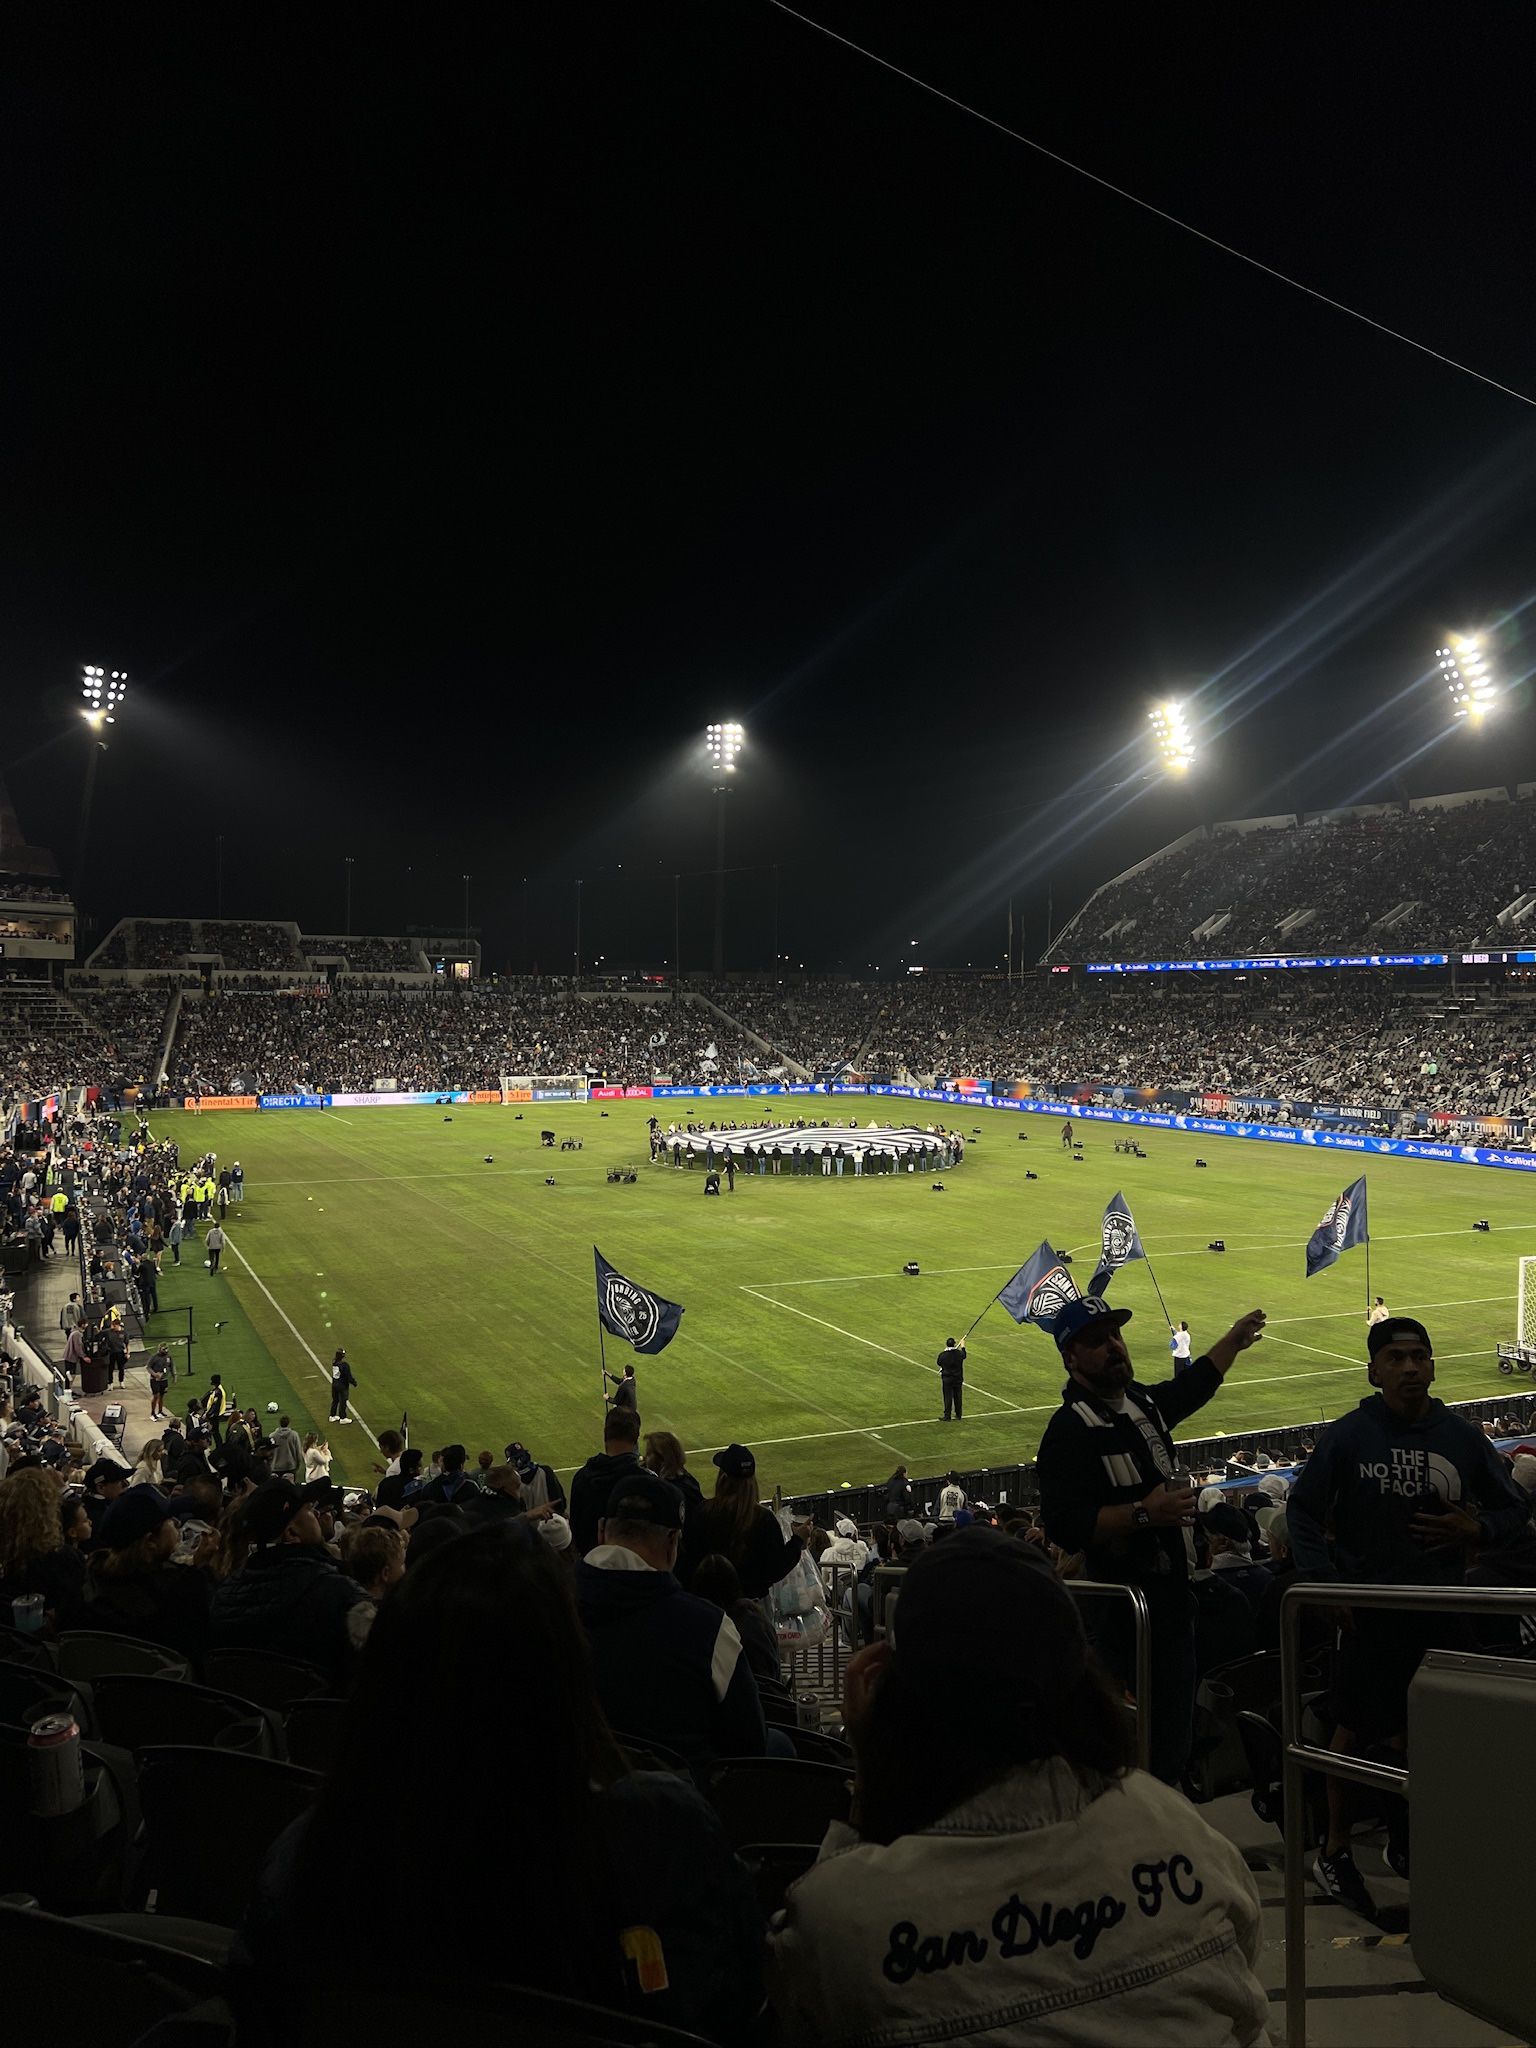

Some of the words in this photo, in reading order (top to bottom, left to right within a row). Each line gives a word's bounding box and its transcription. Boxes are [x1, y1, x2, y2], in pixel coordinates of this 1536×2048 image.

[263, 1097, 301, 1106] DIRECTV
[354, 1096, 381, 1104] SHARP
[1364, 1109, 1381, 1120] FIELD
[1269, 1130, 1296, 1139] SeaWorld
[1335, 1137, 1365, 1147] SeaWorld
[1420, 1147, 1452, 1157] SeaWorld
[1052, 1273, 1071, 1291] SAN
[1390, 1448, 1425, 1466] THE
[1360, 1462, 1428, 1482] NORTH
[882, 1920, 989, 1985] San
[991, 1893, 1127, 1961] Diego
[1131, 1854, 1204, 1918] FC
